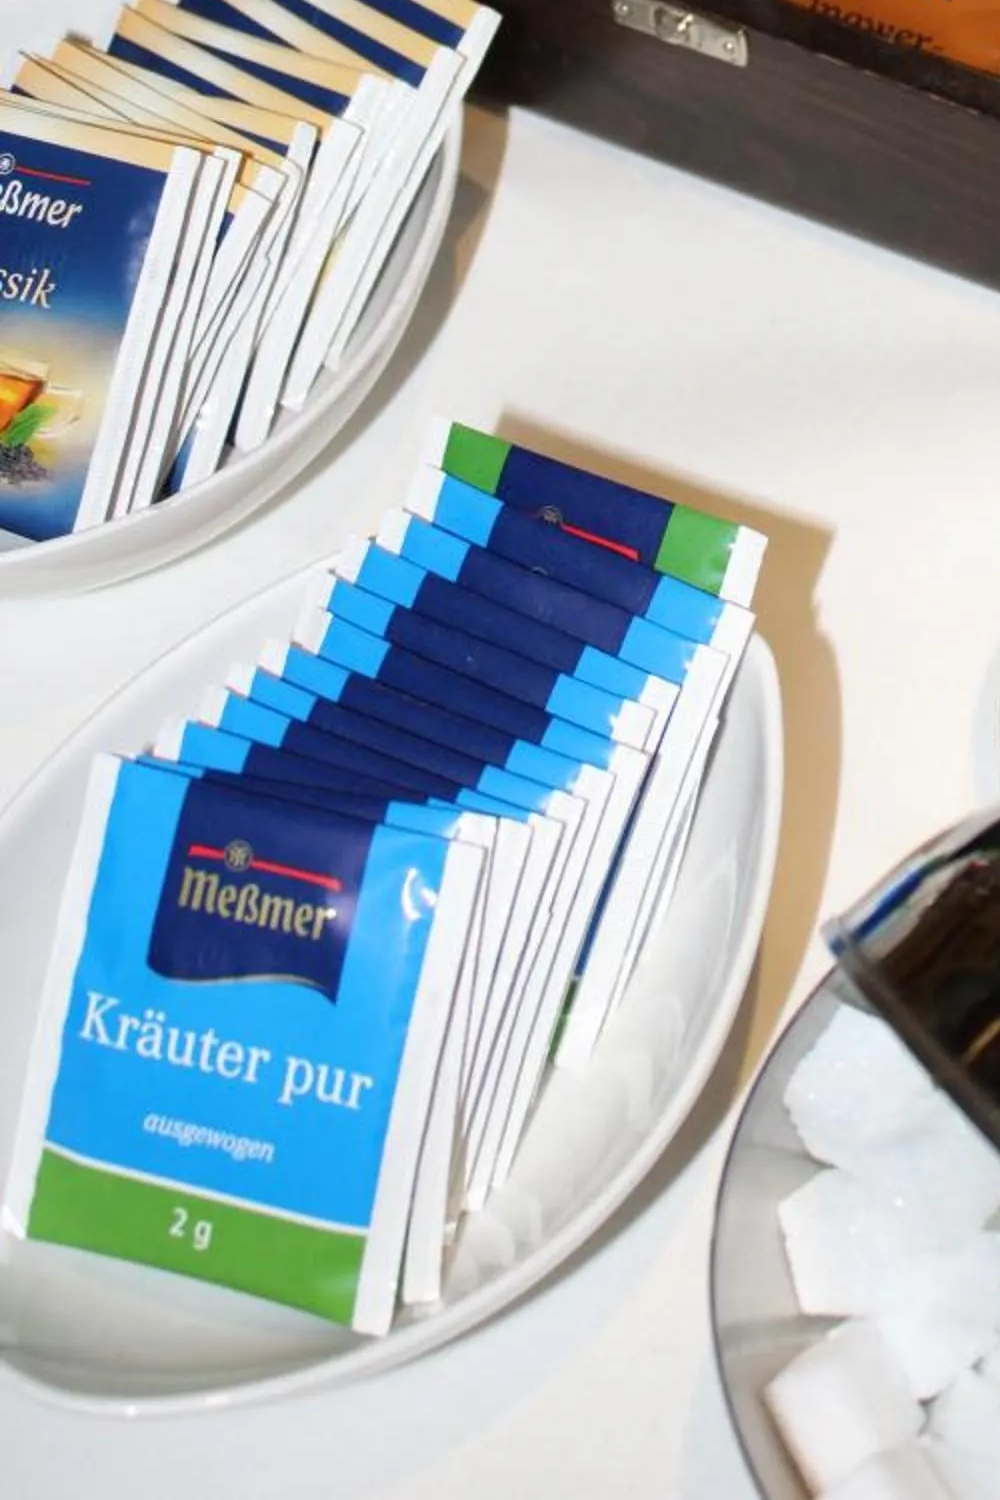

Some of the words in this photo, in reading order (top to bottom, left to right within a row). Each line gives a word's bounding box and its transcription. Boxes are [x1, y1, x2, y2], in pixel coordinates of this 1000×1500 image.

[0, 179, 83, 229] ßmer
[178, 865, 337, 940] Meßmer
[79, 990, 272, 1084] Kräuter
[277, 1054, 374, 1110] pur
[143, 1113, 275, 1164] ausgewogen
[168, 1206, 189, 1238] 2
[192, 1219, 213, 1252] g
